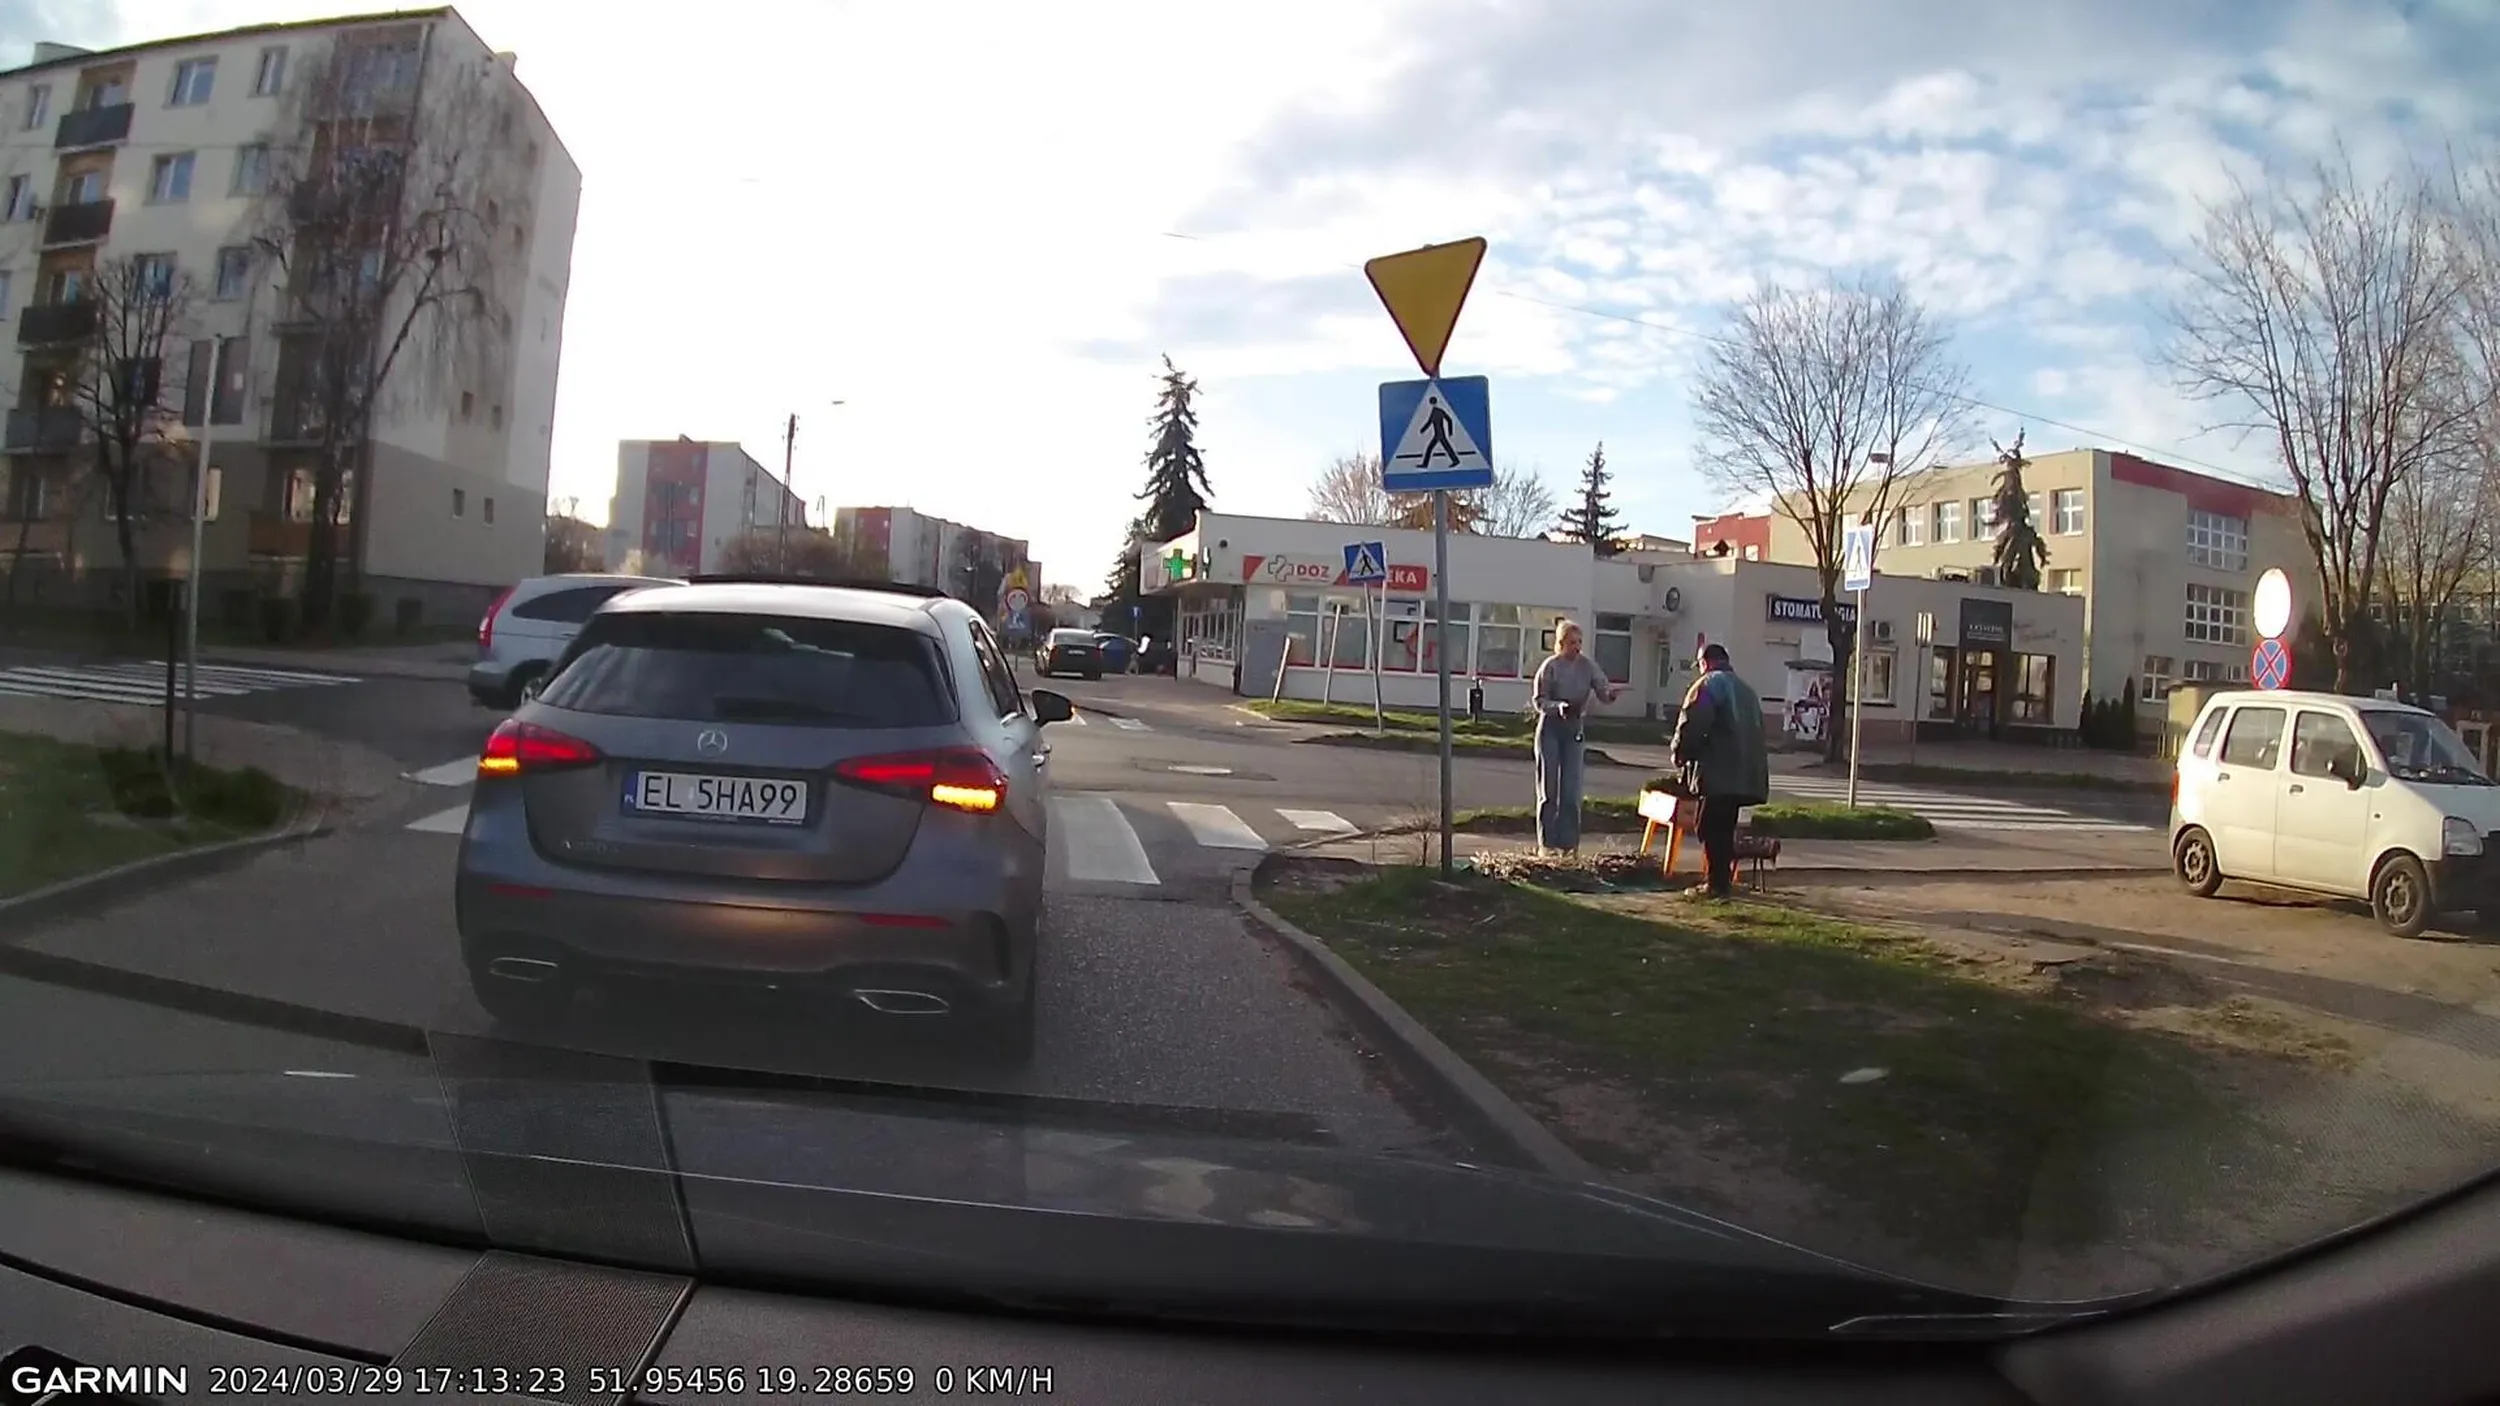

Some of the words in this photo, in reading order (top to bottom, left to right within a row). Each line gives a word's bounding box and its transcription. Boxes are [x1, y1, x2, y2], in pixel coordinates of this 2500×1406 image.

[1297, 564, 1330, 578] DOZ
[644, 776, 681, 808] EL
[698, 779, 798, 814] 5HA99
